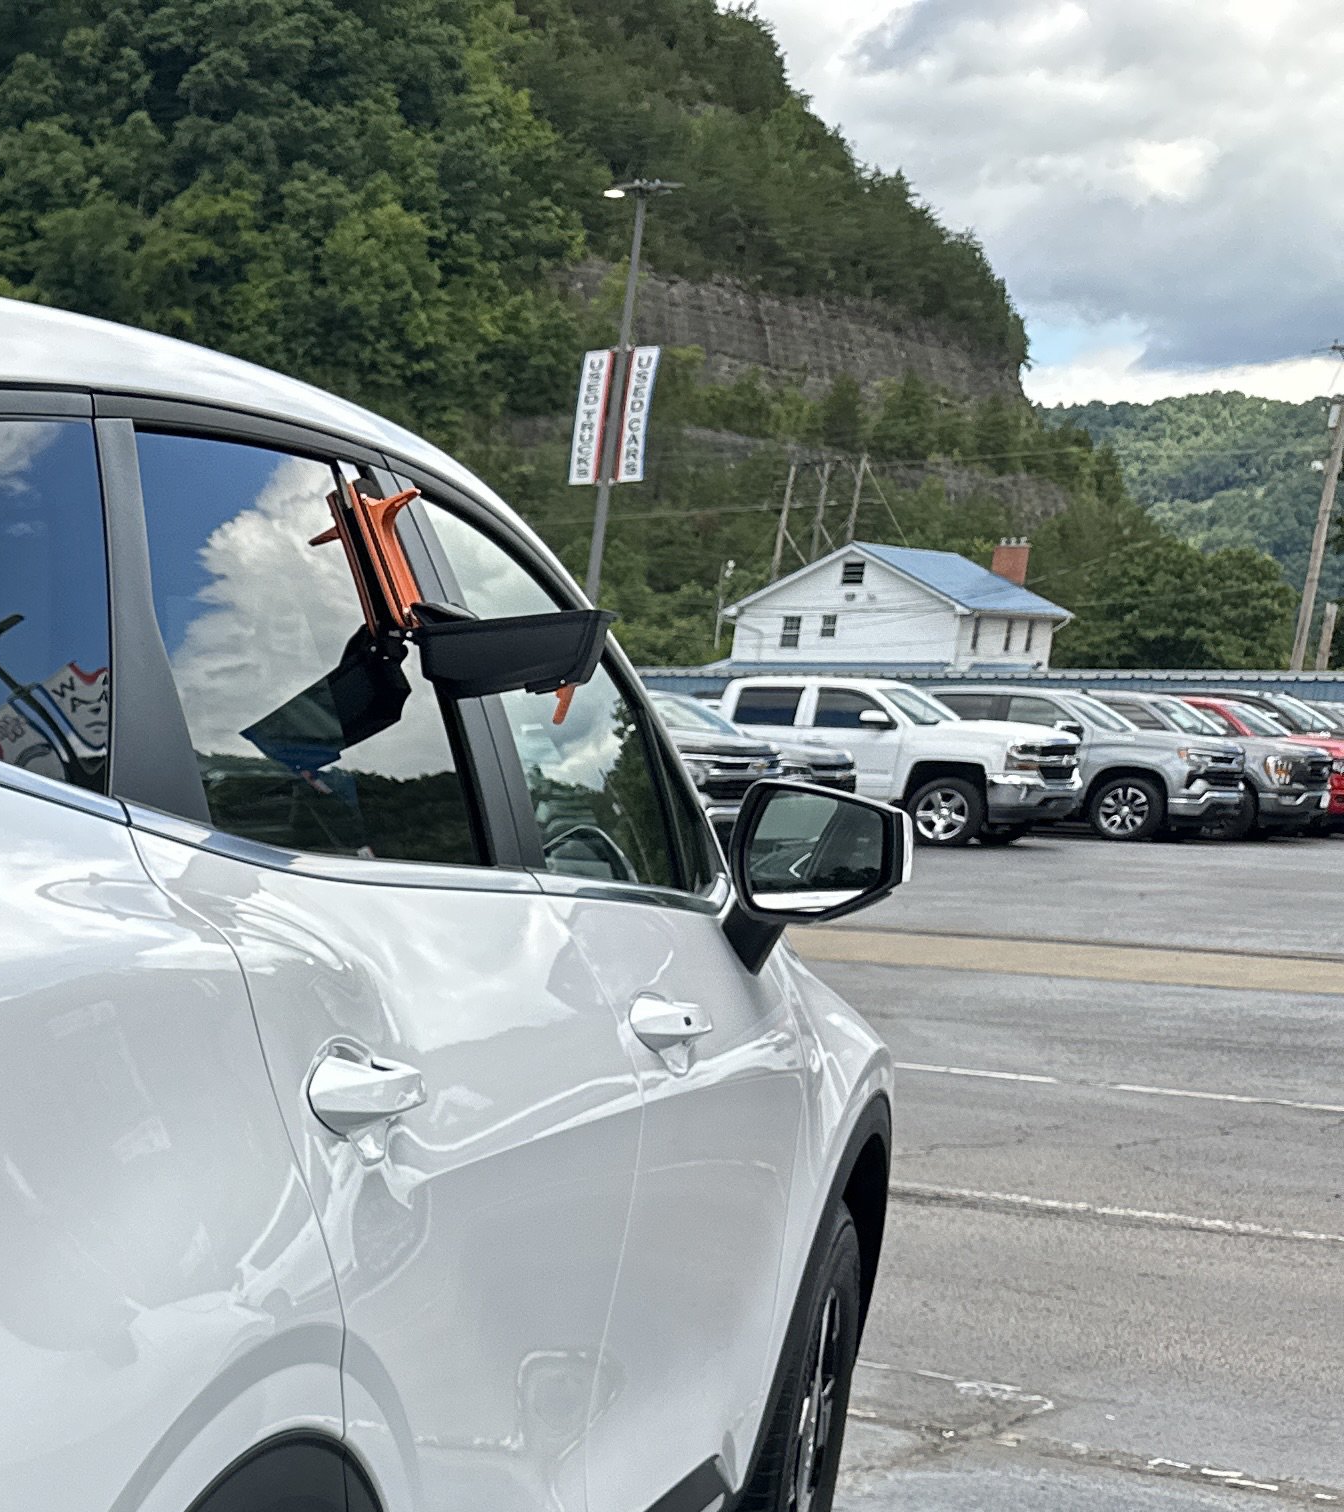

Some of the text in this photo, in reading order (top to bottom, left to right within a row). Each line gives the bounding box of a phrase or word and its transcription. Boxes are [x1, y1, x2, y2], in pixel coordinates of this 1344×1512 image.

[576, 358, 604, 479] USED TRUCKS
[624, 355, 652, 476] USED CARS
